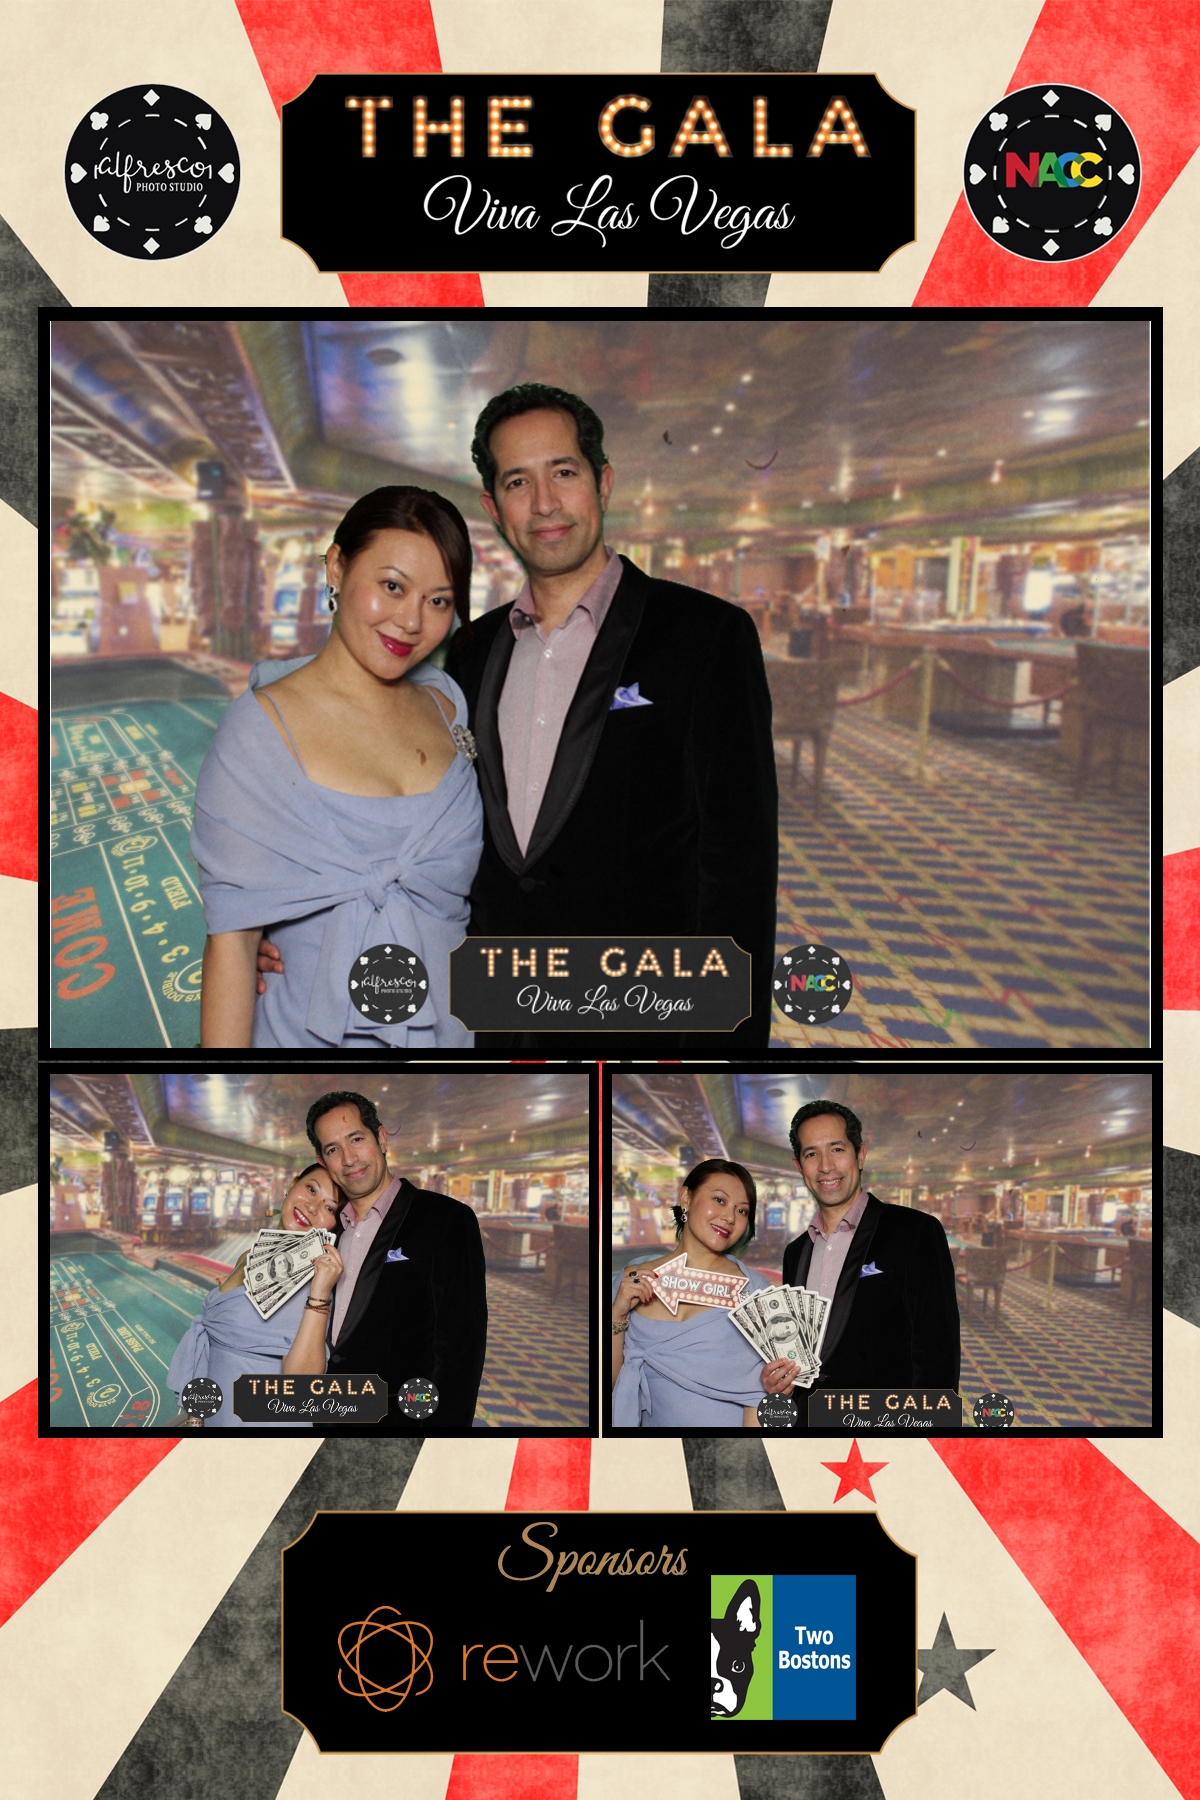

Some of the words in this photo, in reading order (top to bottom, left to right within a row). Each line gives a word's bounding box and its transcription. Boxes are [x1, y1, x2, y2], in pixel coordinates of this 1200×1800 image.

[160, 876, 193, 910] FIELD
[50, 886, 116, 1000] COME
[661, 1275, 701, 1296] SHOW
[703, 1281, 732, 1299] GIRL
